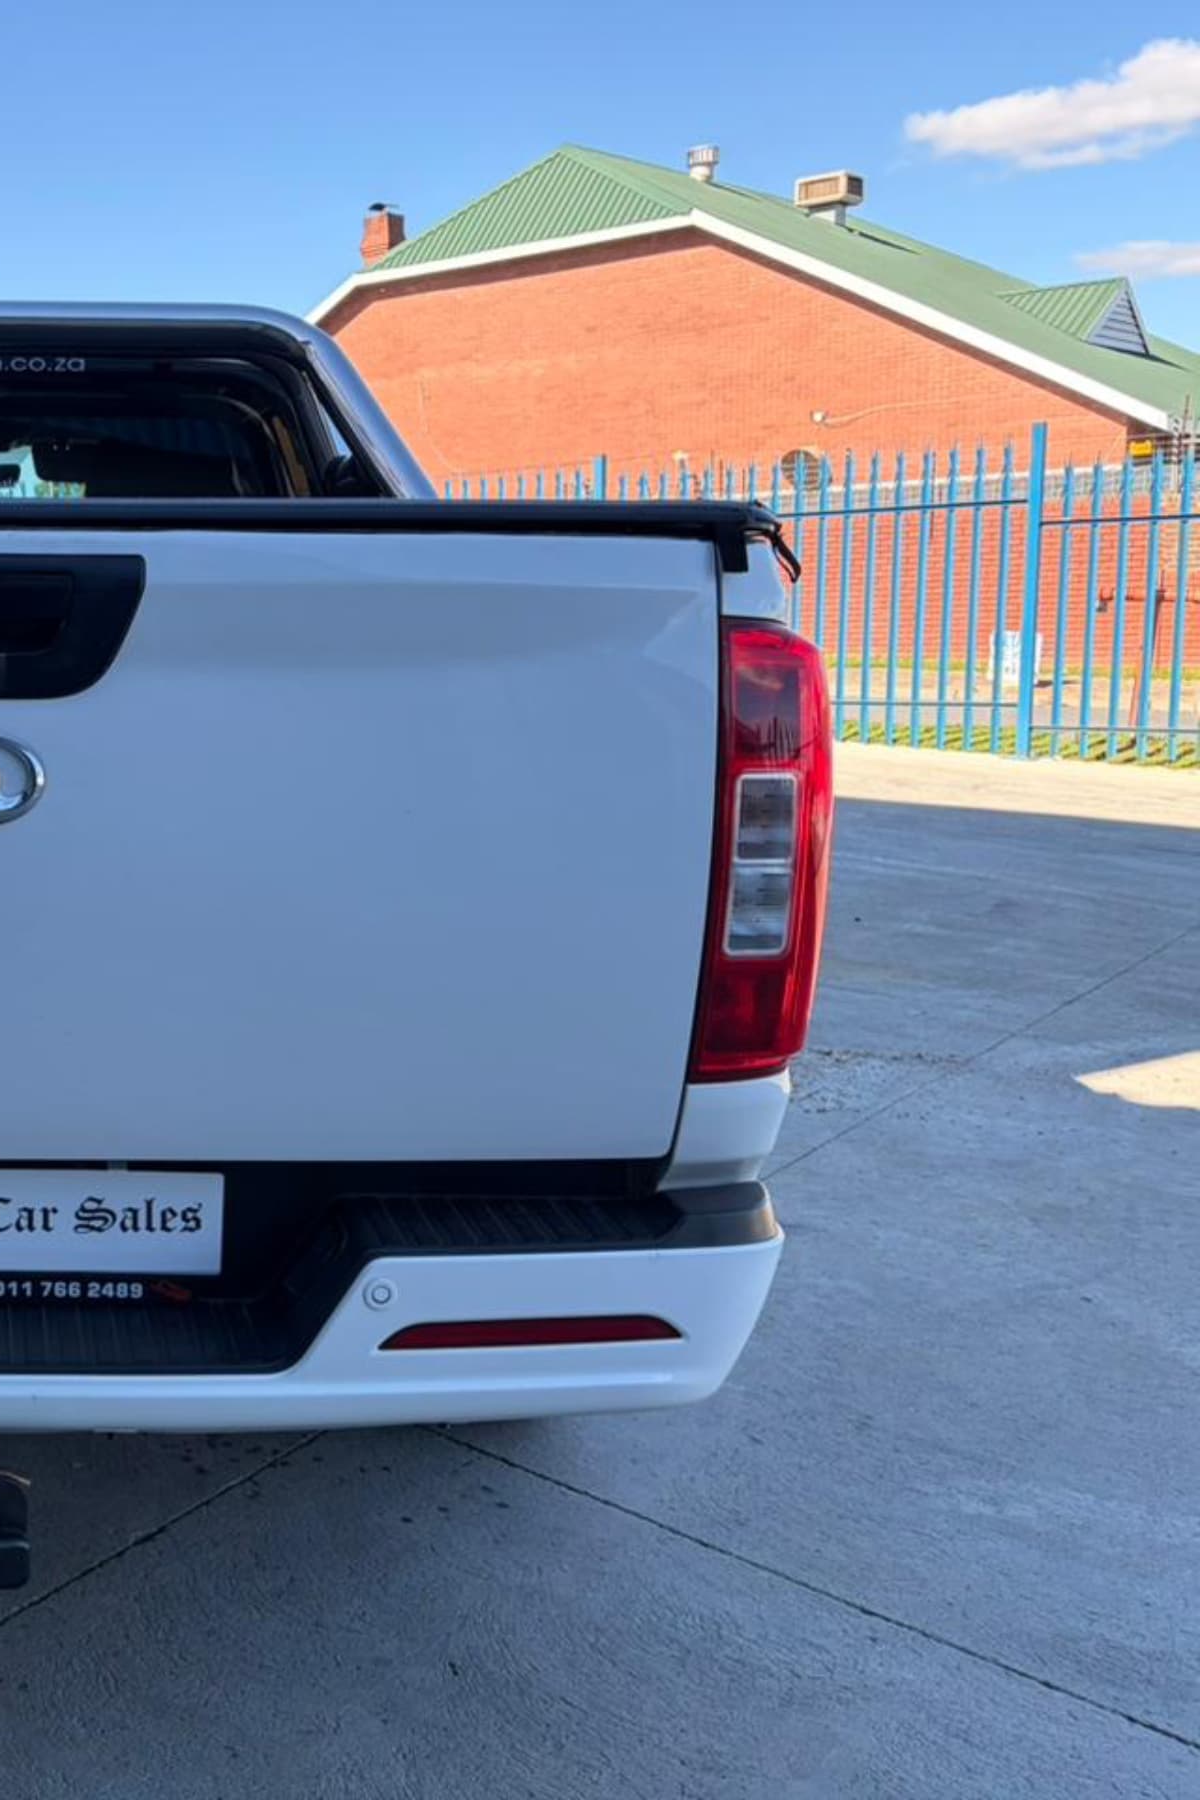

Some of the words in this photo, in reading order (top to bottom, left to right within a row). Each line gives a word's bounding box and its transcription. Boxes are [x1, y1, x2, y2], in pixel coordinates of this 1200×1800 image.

[73, 1196, 203, 1234] Sales
[40, 1281, 81, 1298] 766
[87, 1281, 143, 1299] 2489
